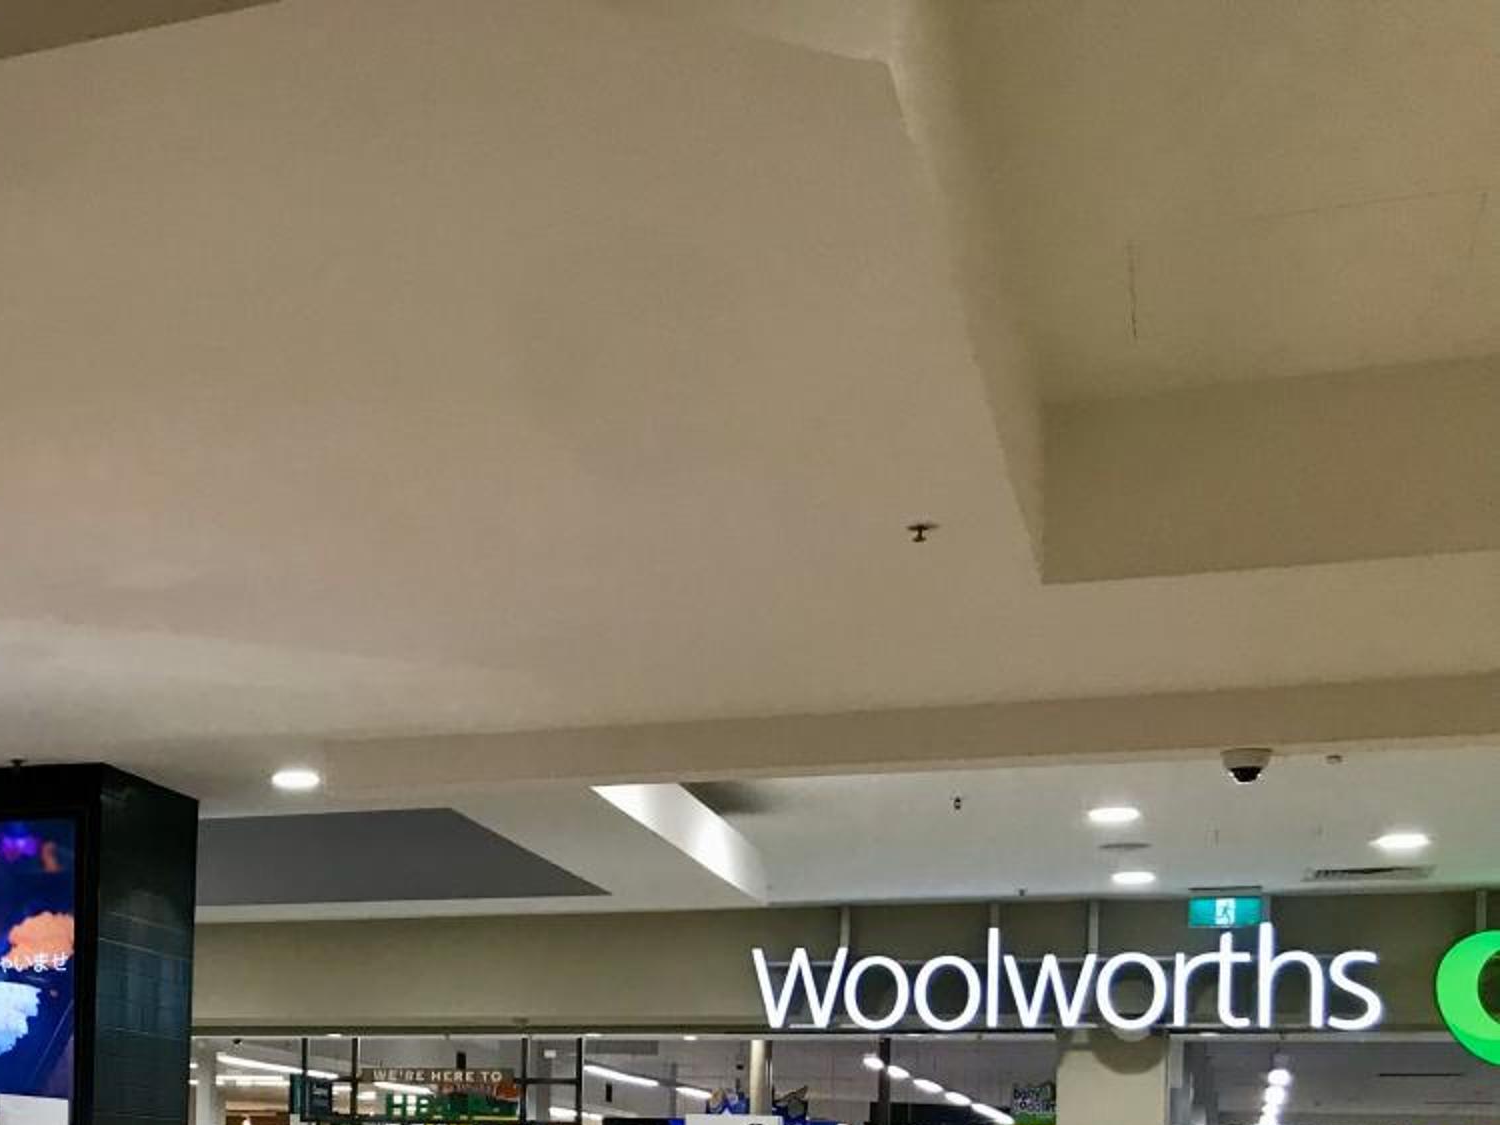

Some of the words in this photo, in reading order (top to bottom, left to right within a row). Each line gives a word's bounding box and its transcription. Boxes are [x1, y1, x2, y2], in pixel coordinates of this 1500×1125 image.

[752, 922, 1384, 1031] Woolworths
[431, 1070, 474, 1081] HERE
[481, 1071, 502, 1082] TO
